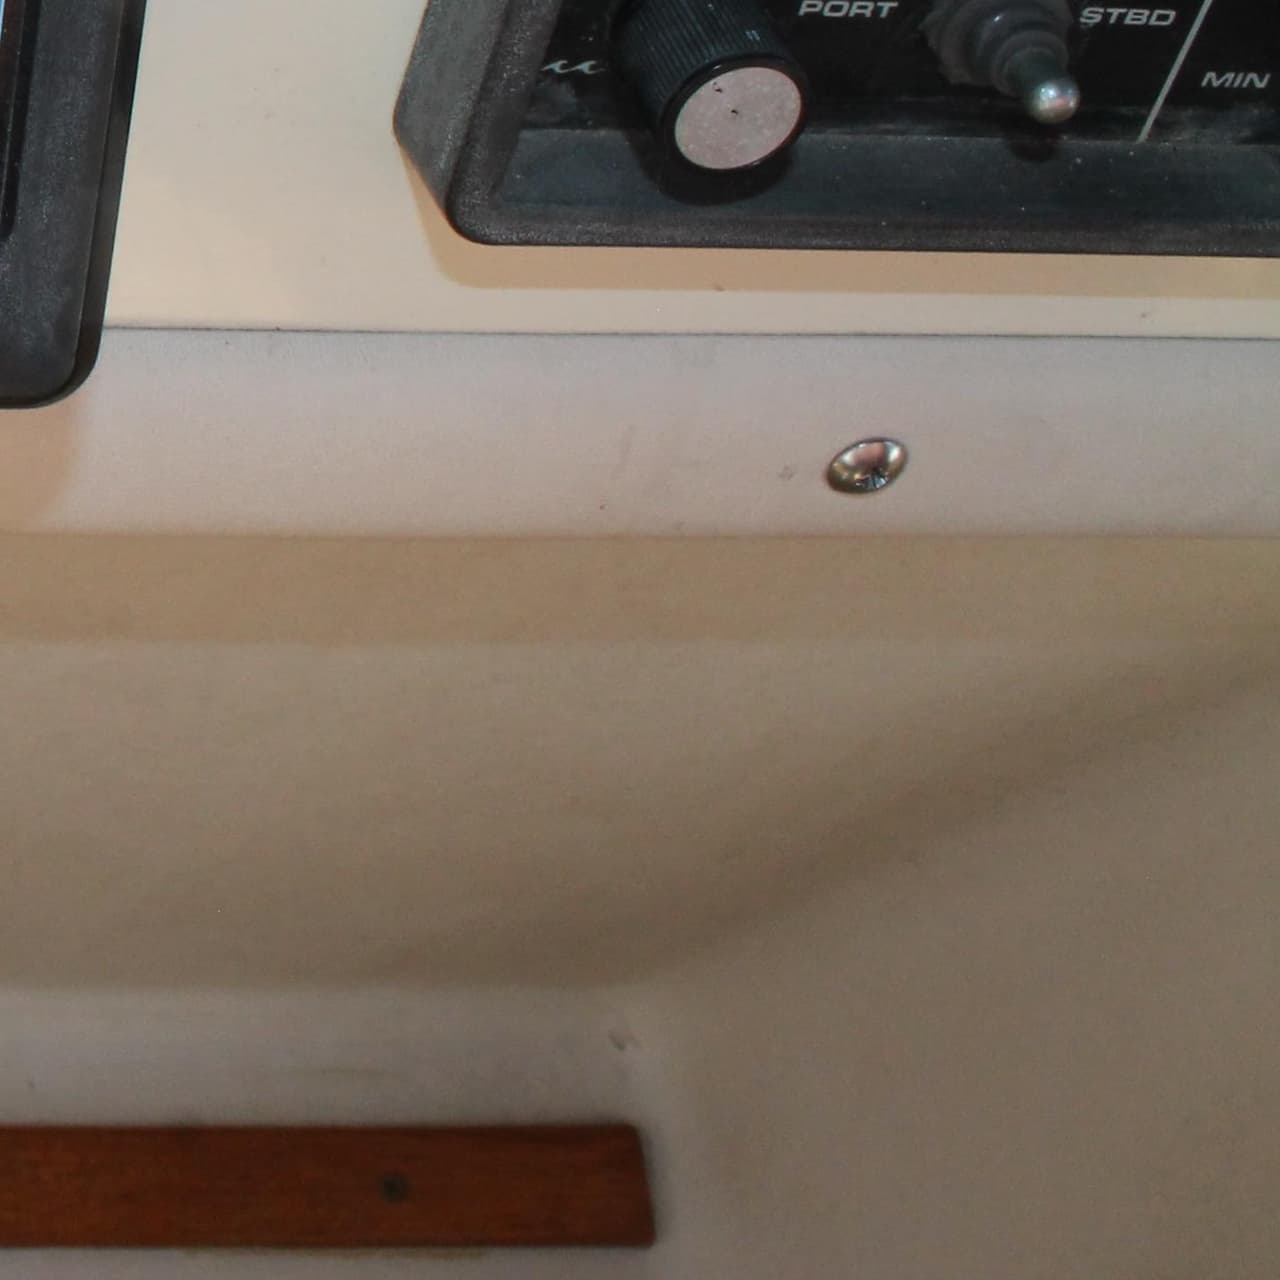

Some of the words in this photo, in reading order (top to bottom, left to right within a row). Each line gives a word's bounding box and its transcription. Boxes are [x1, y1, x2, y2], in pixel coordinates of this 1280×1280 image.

[798, 0, 899, 19] PORT
[1079, 7, 1177, 27] STBD
[1200, 71, 1271, 90] MIN
